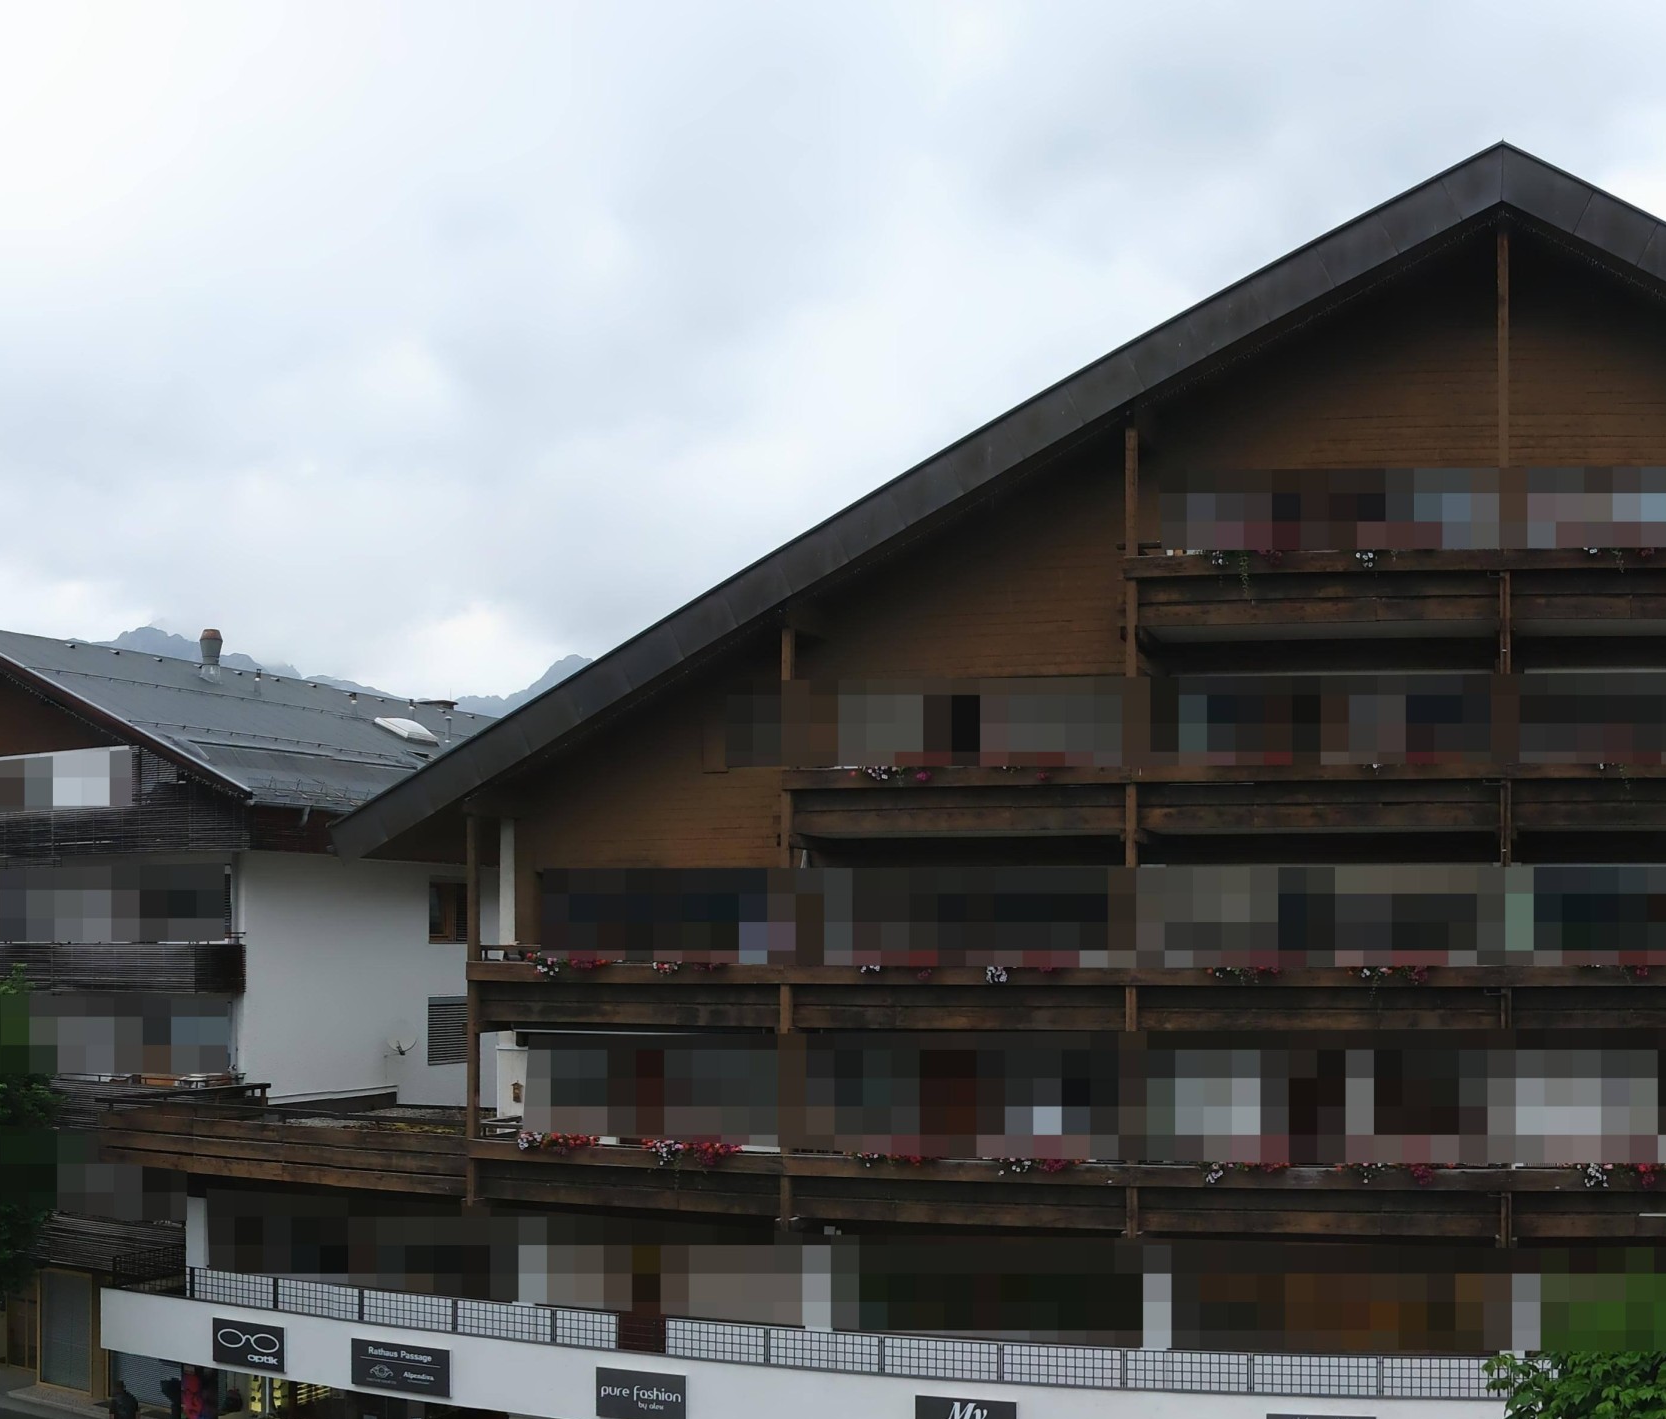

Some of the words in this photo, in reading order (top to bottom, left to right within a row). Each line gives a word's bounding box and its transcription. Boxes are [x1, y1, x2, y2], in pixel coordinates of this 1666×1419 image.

[368, 1346, 398, 1359] Rathaus
[400, 1351, 432, 1362] Passage
[601, 1385, 629, 1397] pure
[634, 1386, 681, 1402] fashion
[638, 1401, 647, 1411] by
